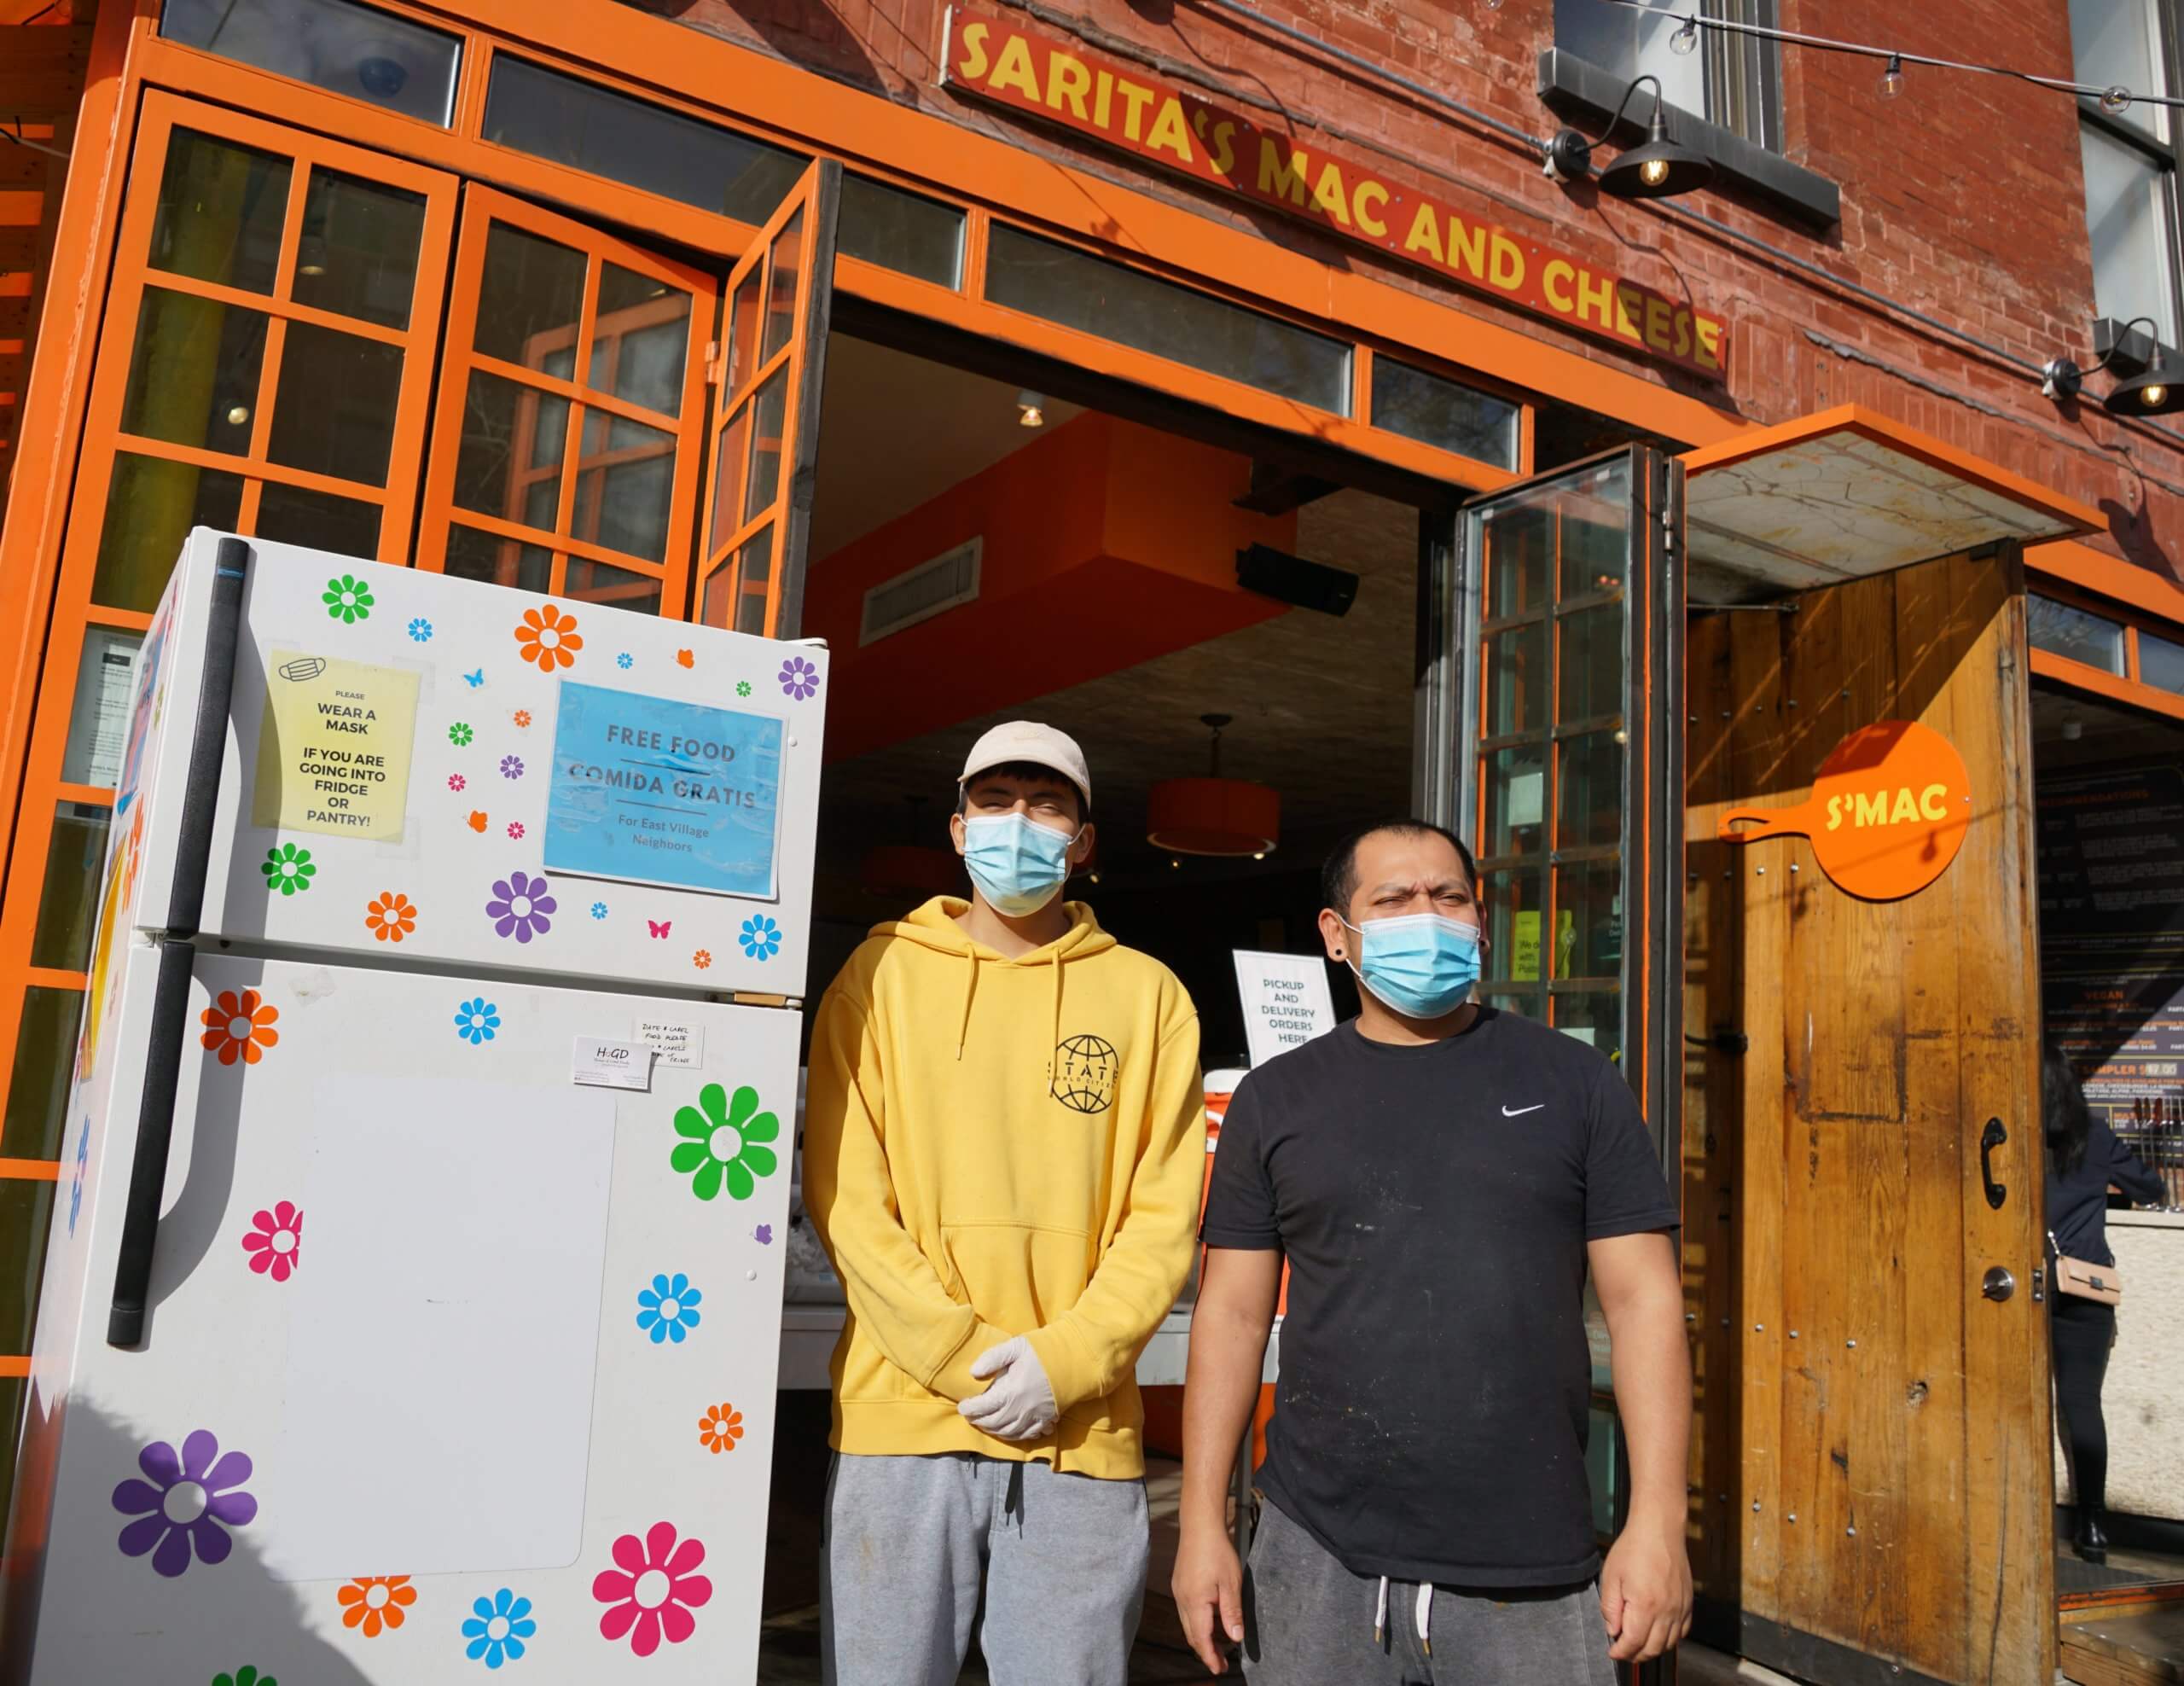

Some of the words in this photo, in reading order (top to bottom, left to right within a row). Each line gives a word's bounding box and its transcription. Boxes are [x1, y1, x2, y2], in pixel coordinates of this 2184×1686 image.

[959, 23, 1236, 175] SARITA'S
[1257, 137, 1390, 237] MAC
[1404, 203, 1525, 292] AND
[1542, 259, 1720, 369] CHEESE
[335, 690, 365, 701] PLEASE
[317, 702, 362, 719] WEAR
[365, 710, 376, 721] A
[326, 719, 369, 735] MASK
[607, 724, 662, 750] FREE
[671, 736, 736, 762] FOOD
[303, 747, 317, 759] IF
[321, 749, 351, 763] YOU
[354, 753, 385, 767] ARE
[299, 763, 348, 778] GOING
[351, 769, 386, 782] INTO
[314, 780, 369, 796] FRIDGE
[569, 764, 664, 794] COMIDA
[673, 780, 756, 809] GRATIS
[328, 797, 349, 809] OR
[1826, 783, 1948, 832] S'MAC
[307, 810, 371, 827] PANTRY!
[619, 815, 638, 827] For
[642, 818, 665, 831] East
[669, 822, 710, 838] Village
[632, 834, 693, 852] Neighbors
[1263, 979, 1304, 991] PICKUP
[1274, 993, 1299, 1003] AND
[1261, 1005, 1316, 1018] DELIVERY
[1269, 1019, 1313, 1032] ORDERS
